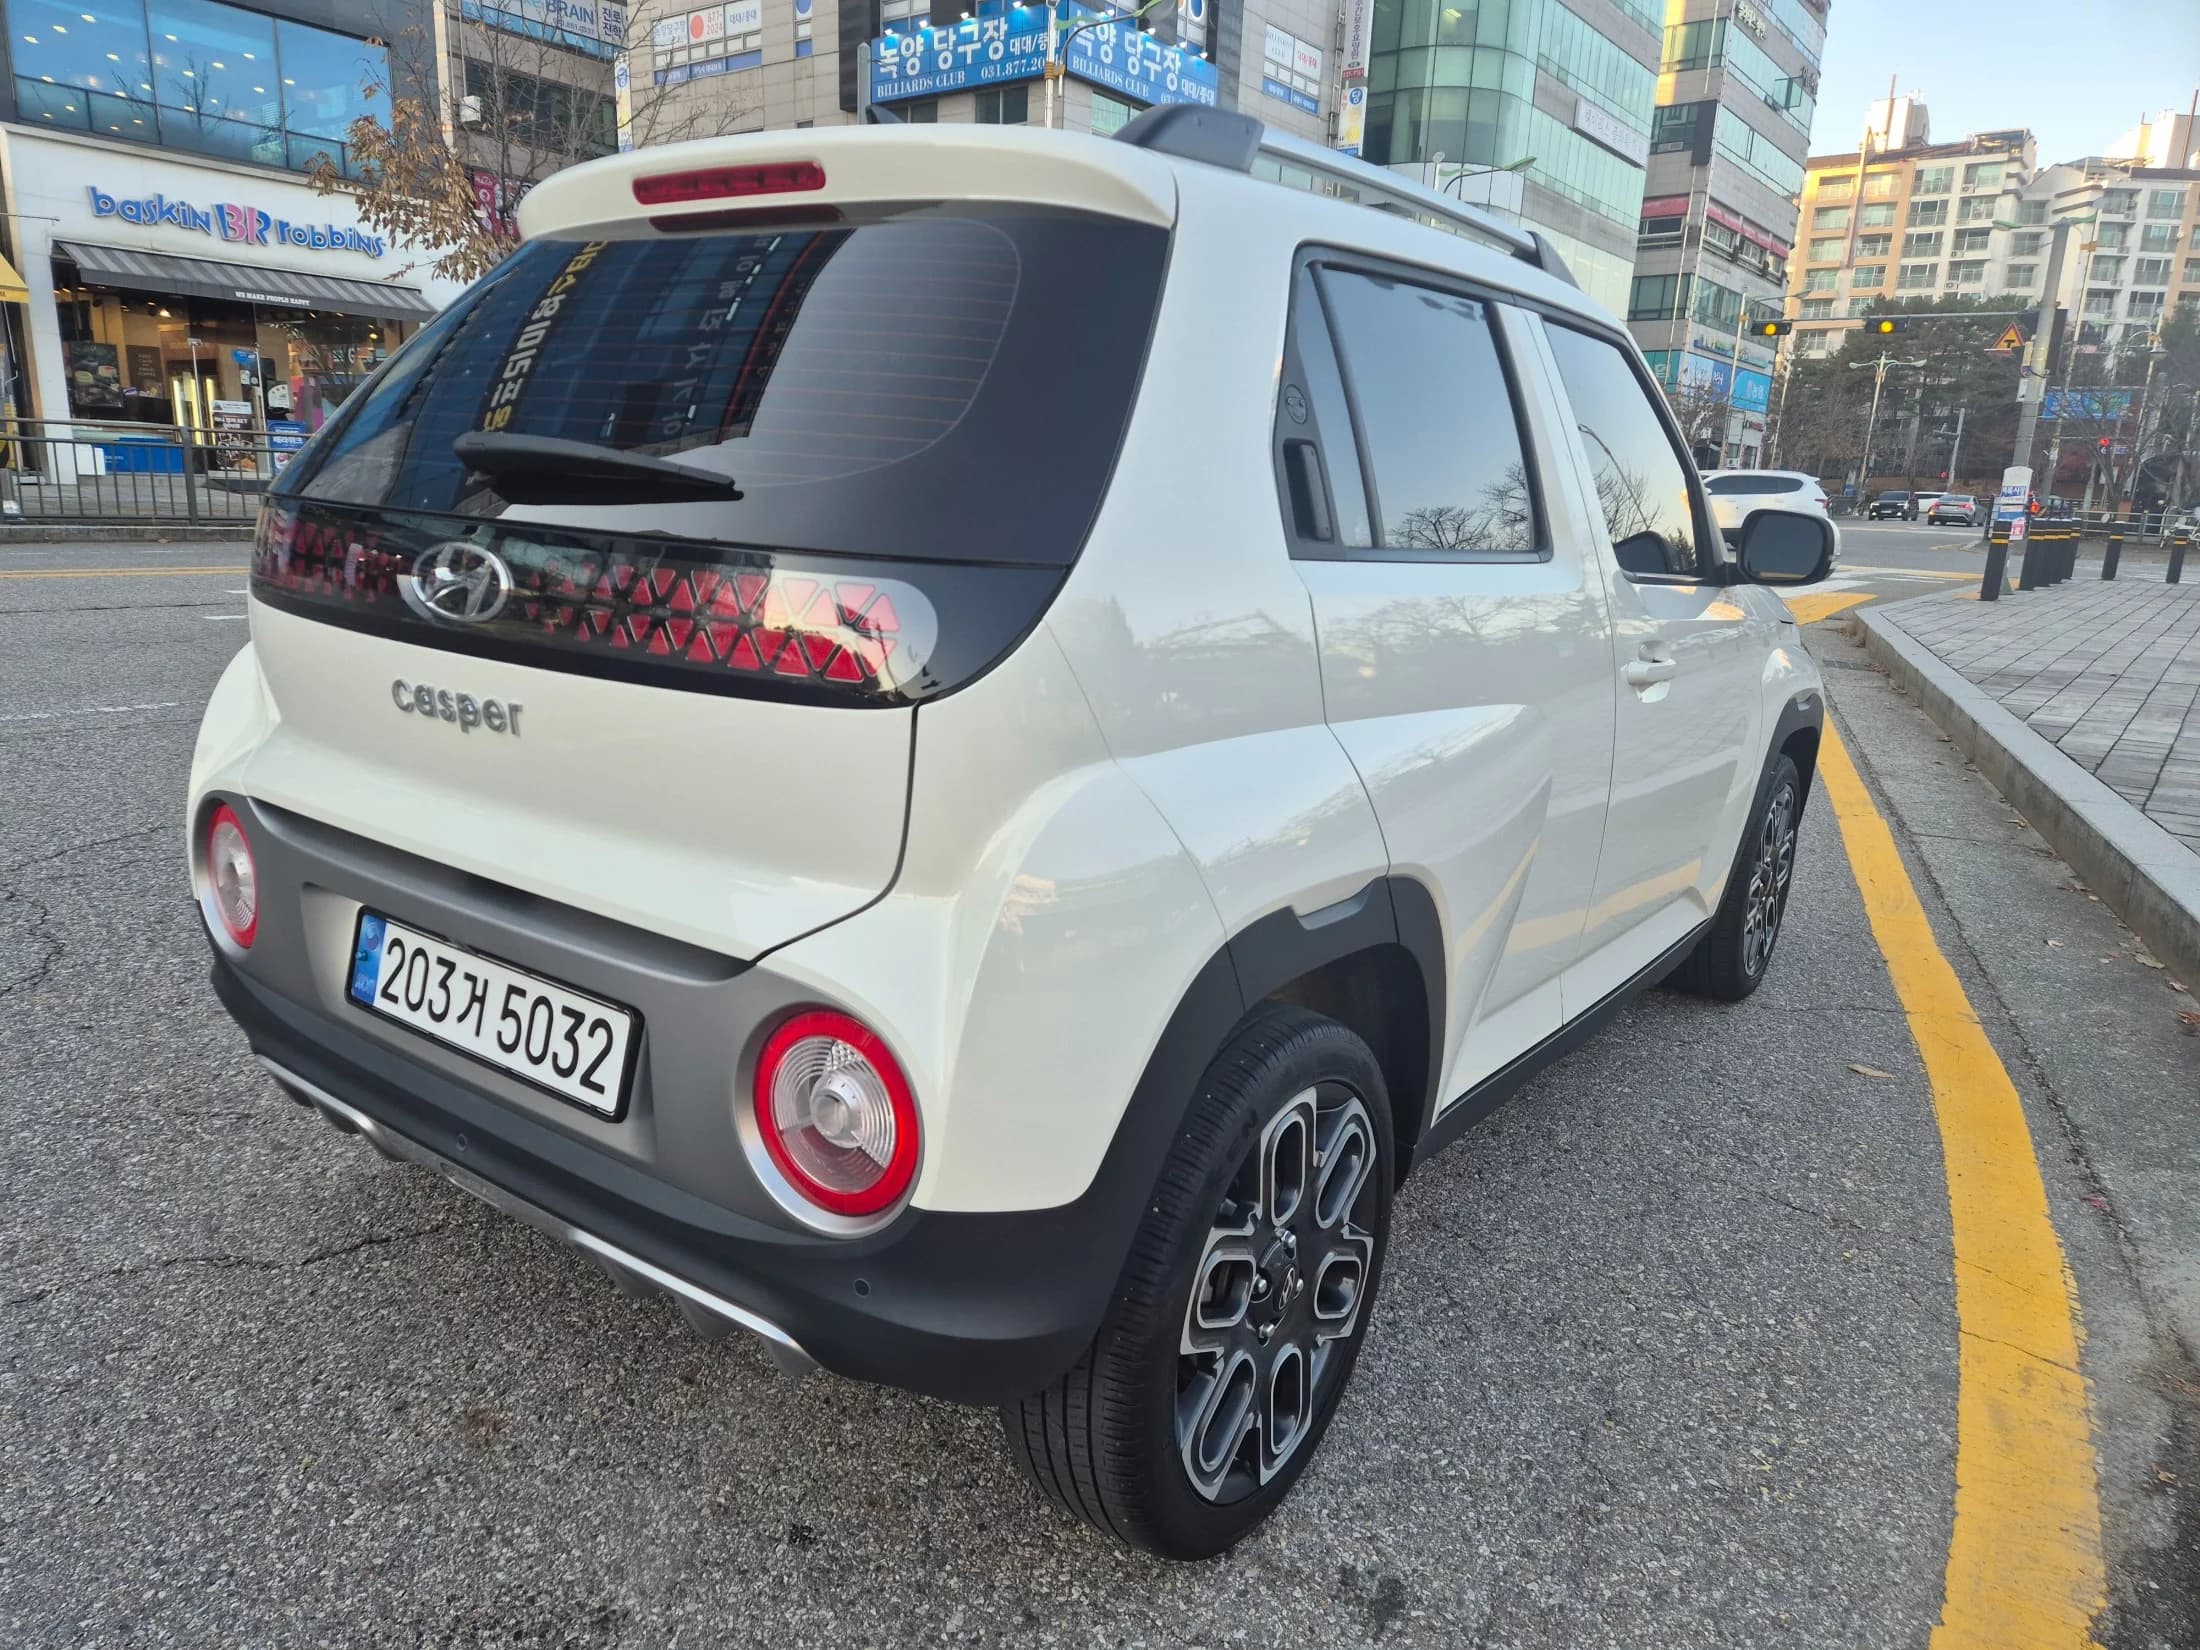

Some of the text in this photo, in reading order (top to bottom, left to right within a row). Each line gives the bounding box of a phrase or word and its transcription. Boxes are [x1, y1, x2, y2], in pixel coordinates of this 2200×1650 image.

[546, 0, 594, 25] BRAIN
[877, 53, 1064, 98] BILLIARDS CLUB 031.877.20
[879, 32, 925, 79] 녹양
[932, 16, 1009, 70] 당구장
[1072, 55, 1149, 97] BILLIARDS CLUB
[1124, 30, 1183, 91] 당구장
[87, 185, 212, 236] baskin
[275, 218, 386, 259] robbins
[391, 678, 524, 737] casper
[380, 937, 615, 1095] 203거 5032
